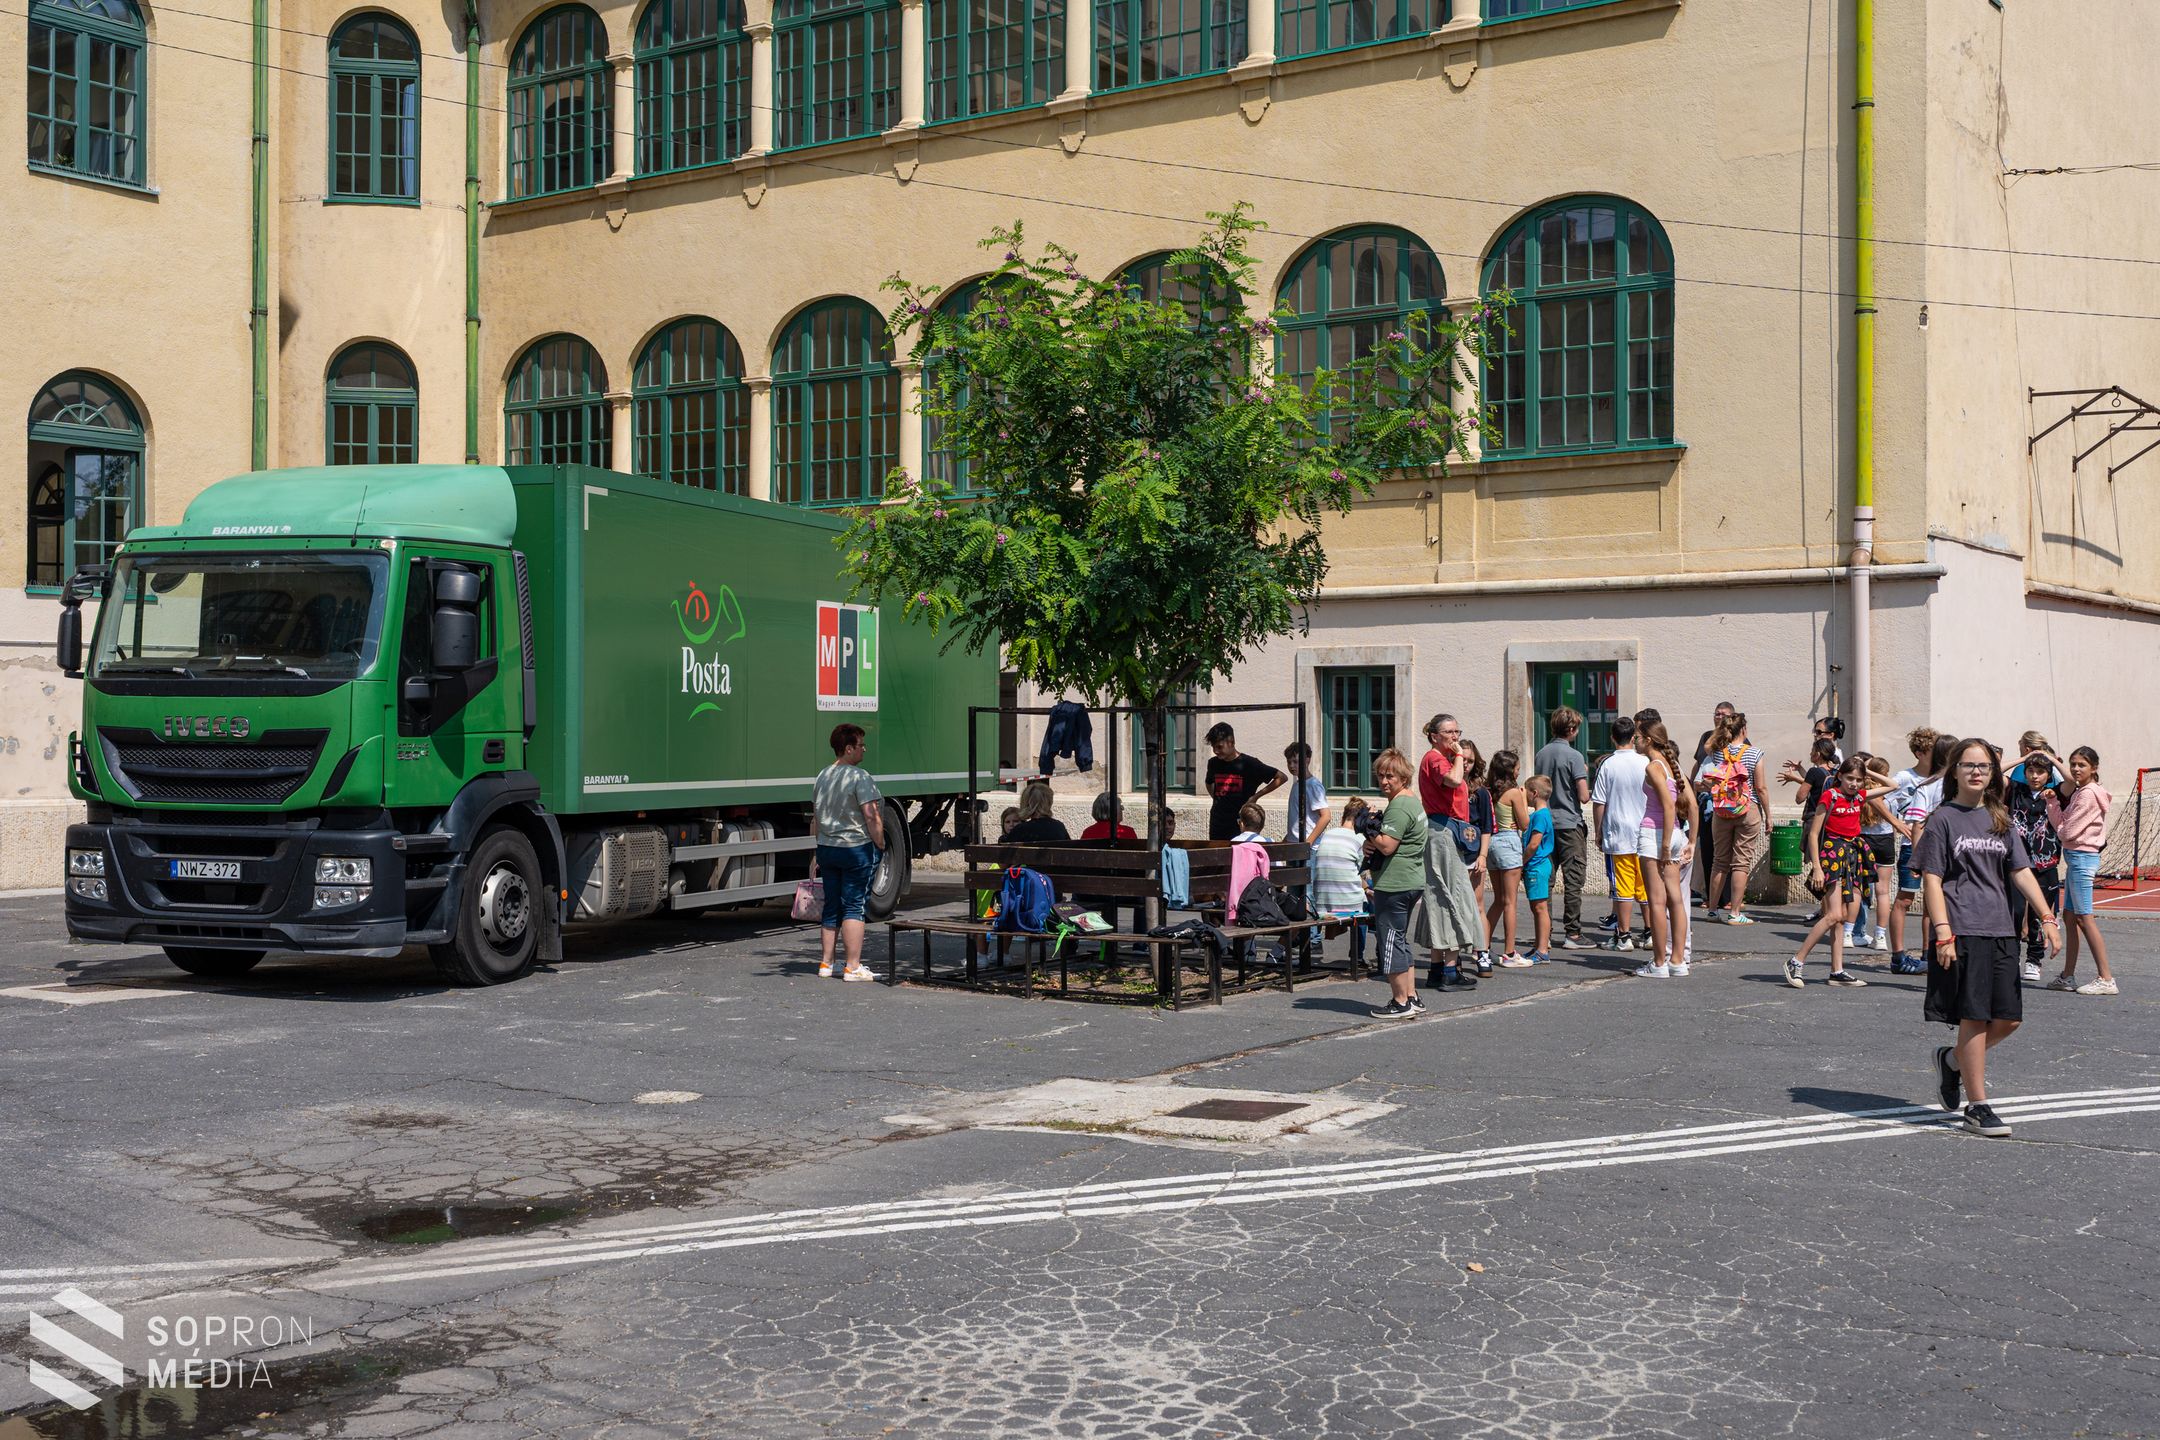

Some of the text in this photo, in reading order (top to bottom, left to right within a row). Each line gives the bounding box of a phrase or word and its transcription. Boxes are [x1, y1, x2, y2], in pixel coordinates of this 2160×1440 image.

[212, 525, 279, 535] BARANYAI
[821, 635, 872, 669] MPL
[681, 646, 732, 695] Posta
[818, 700, 836, 708] Magyar
[164, 716, 250, 737] IVECO
[584, 775, 622, 784] BARANYAI
[180, 862, 238, 877] NWZ-372
